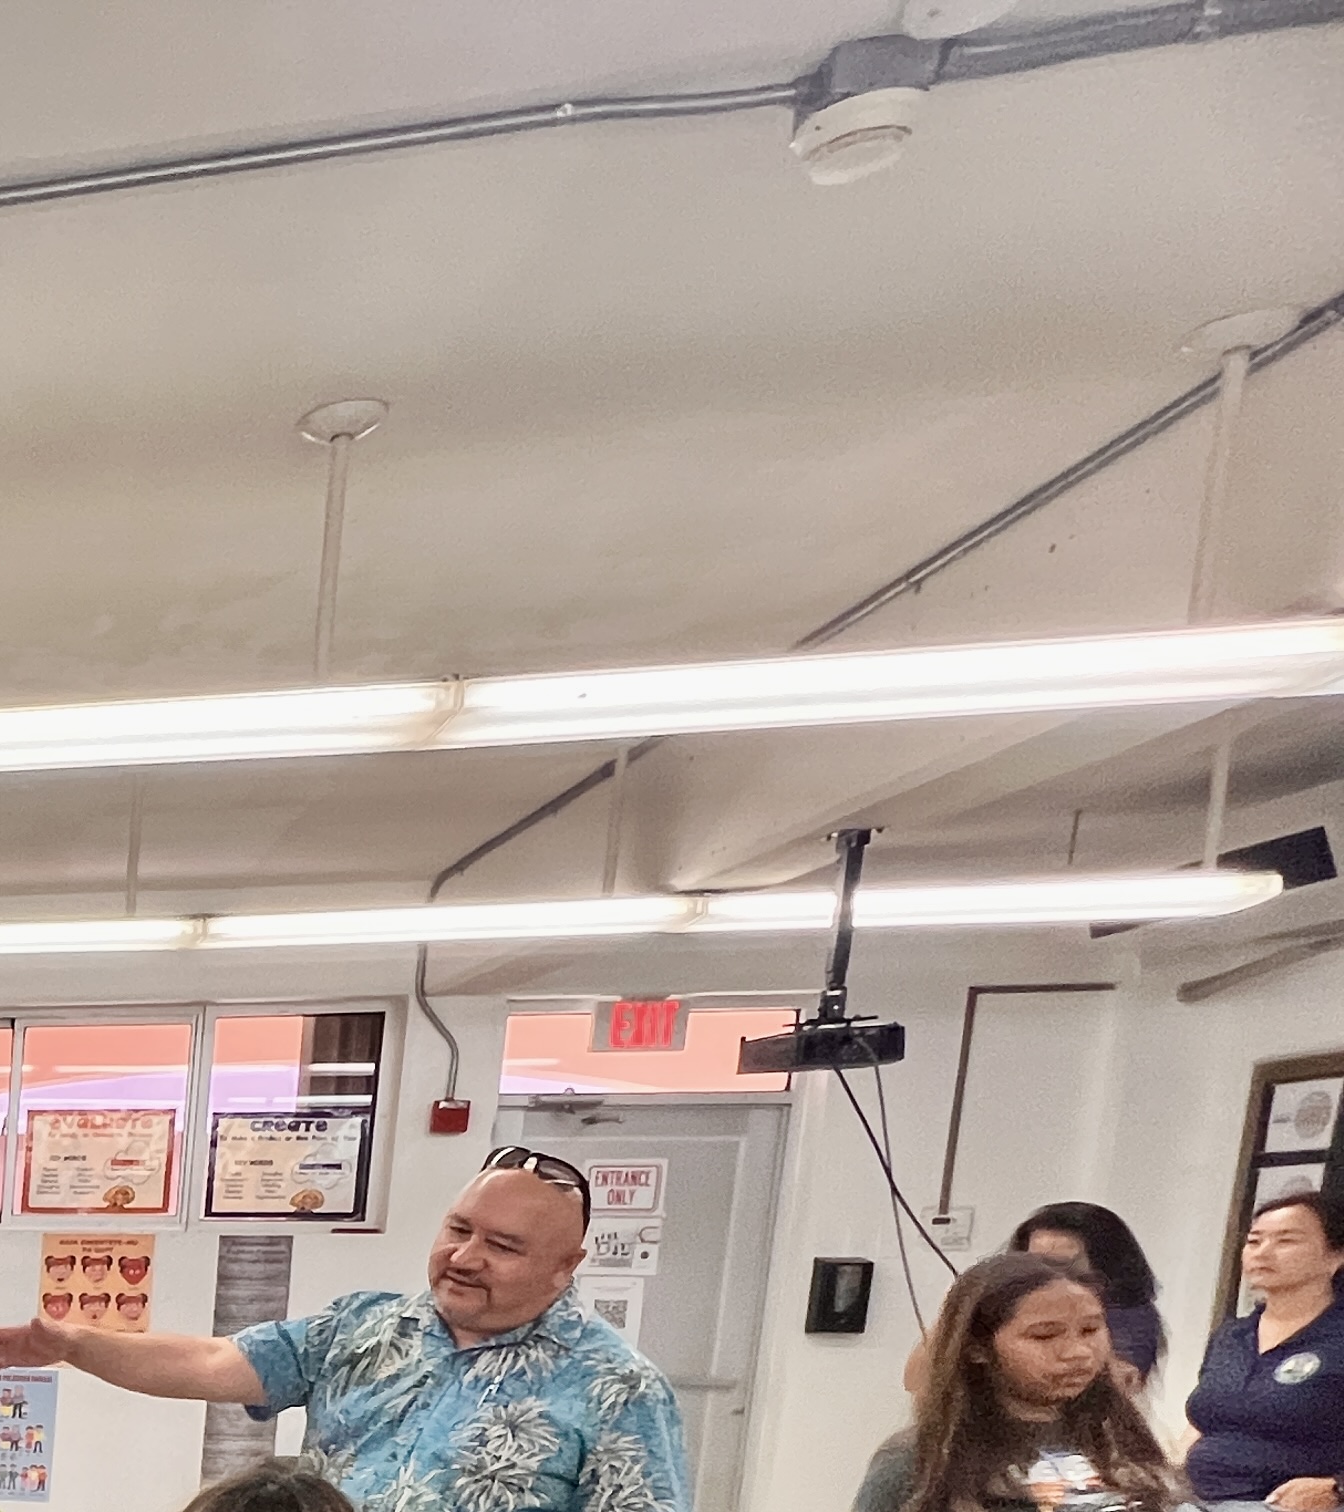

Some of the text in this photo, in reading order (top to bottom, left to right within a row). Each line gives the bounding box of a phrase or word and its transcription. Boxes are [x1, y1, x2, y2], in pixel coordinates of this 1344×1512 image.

[609, 1002, 680, 1048] EXIT
[594, 1170, 652, 1187] ENTRANCE
[607, 1188, 637, 1206] ONLY
